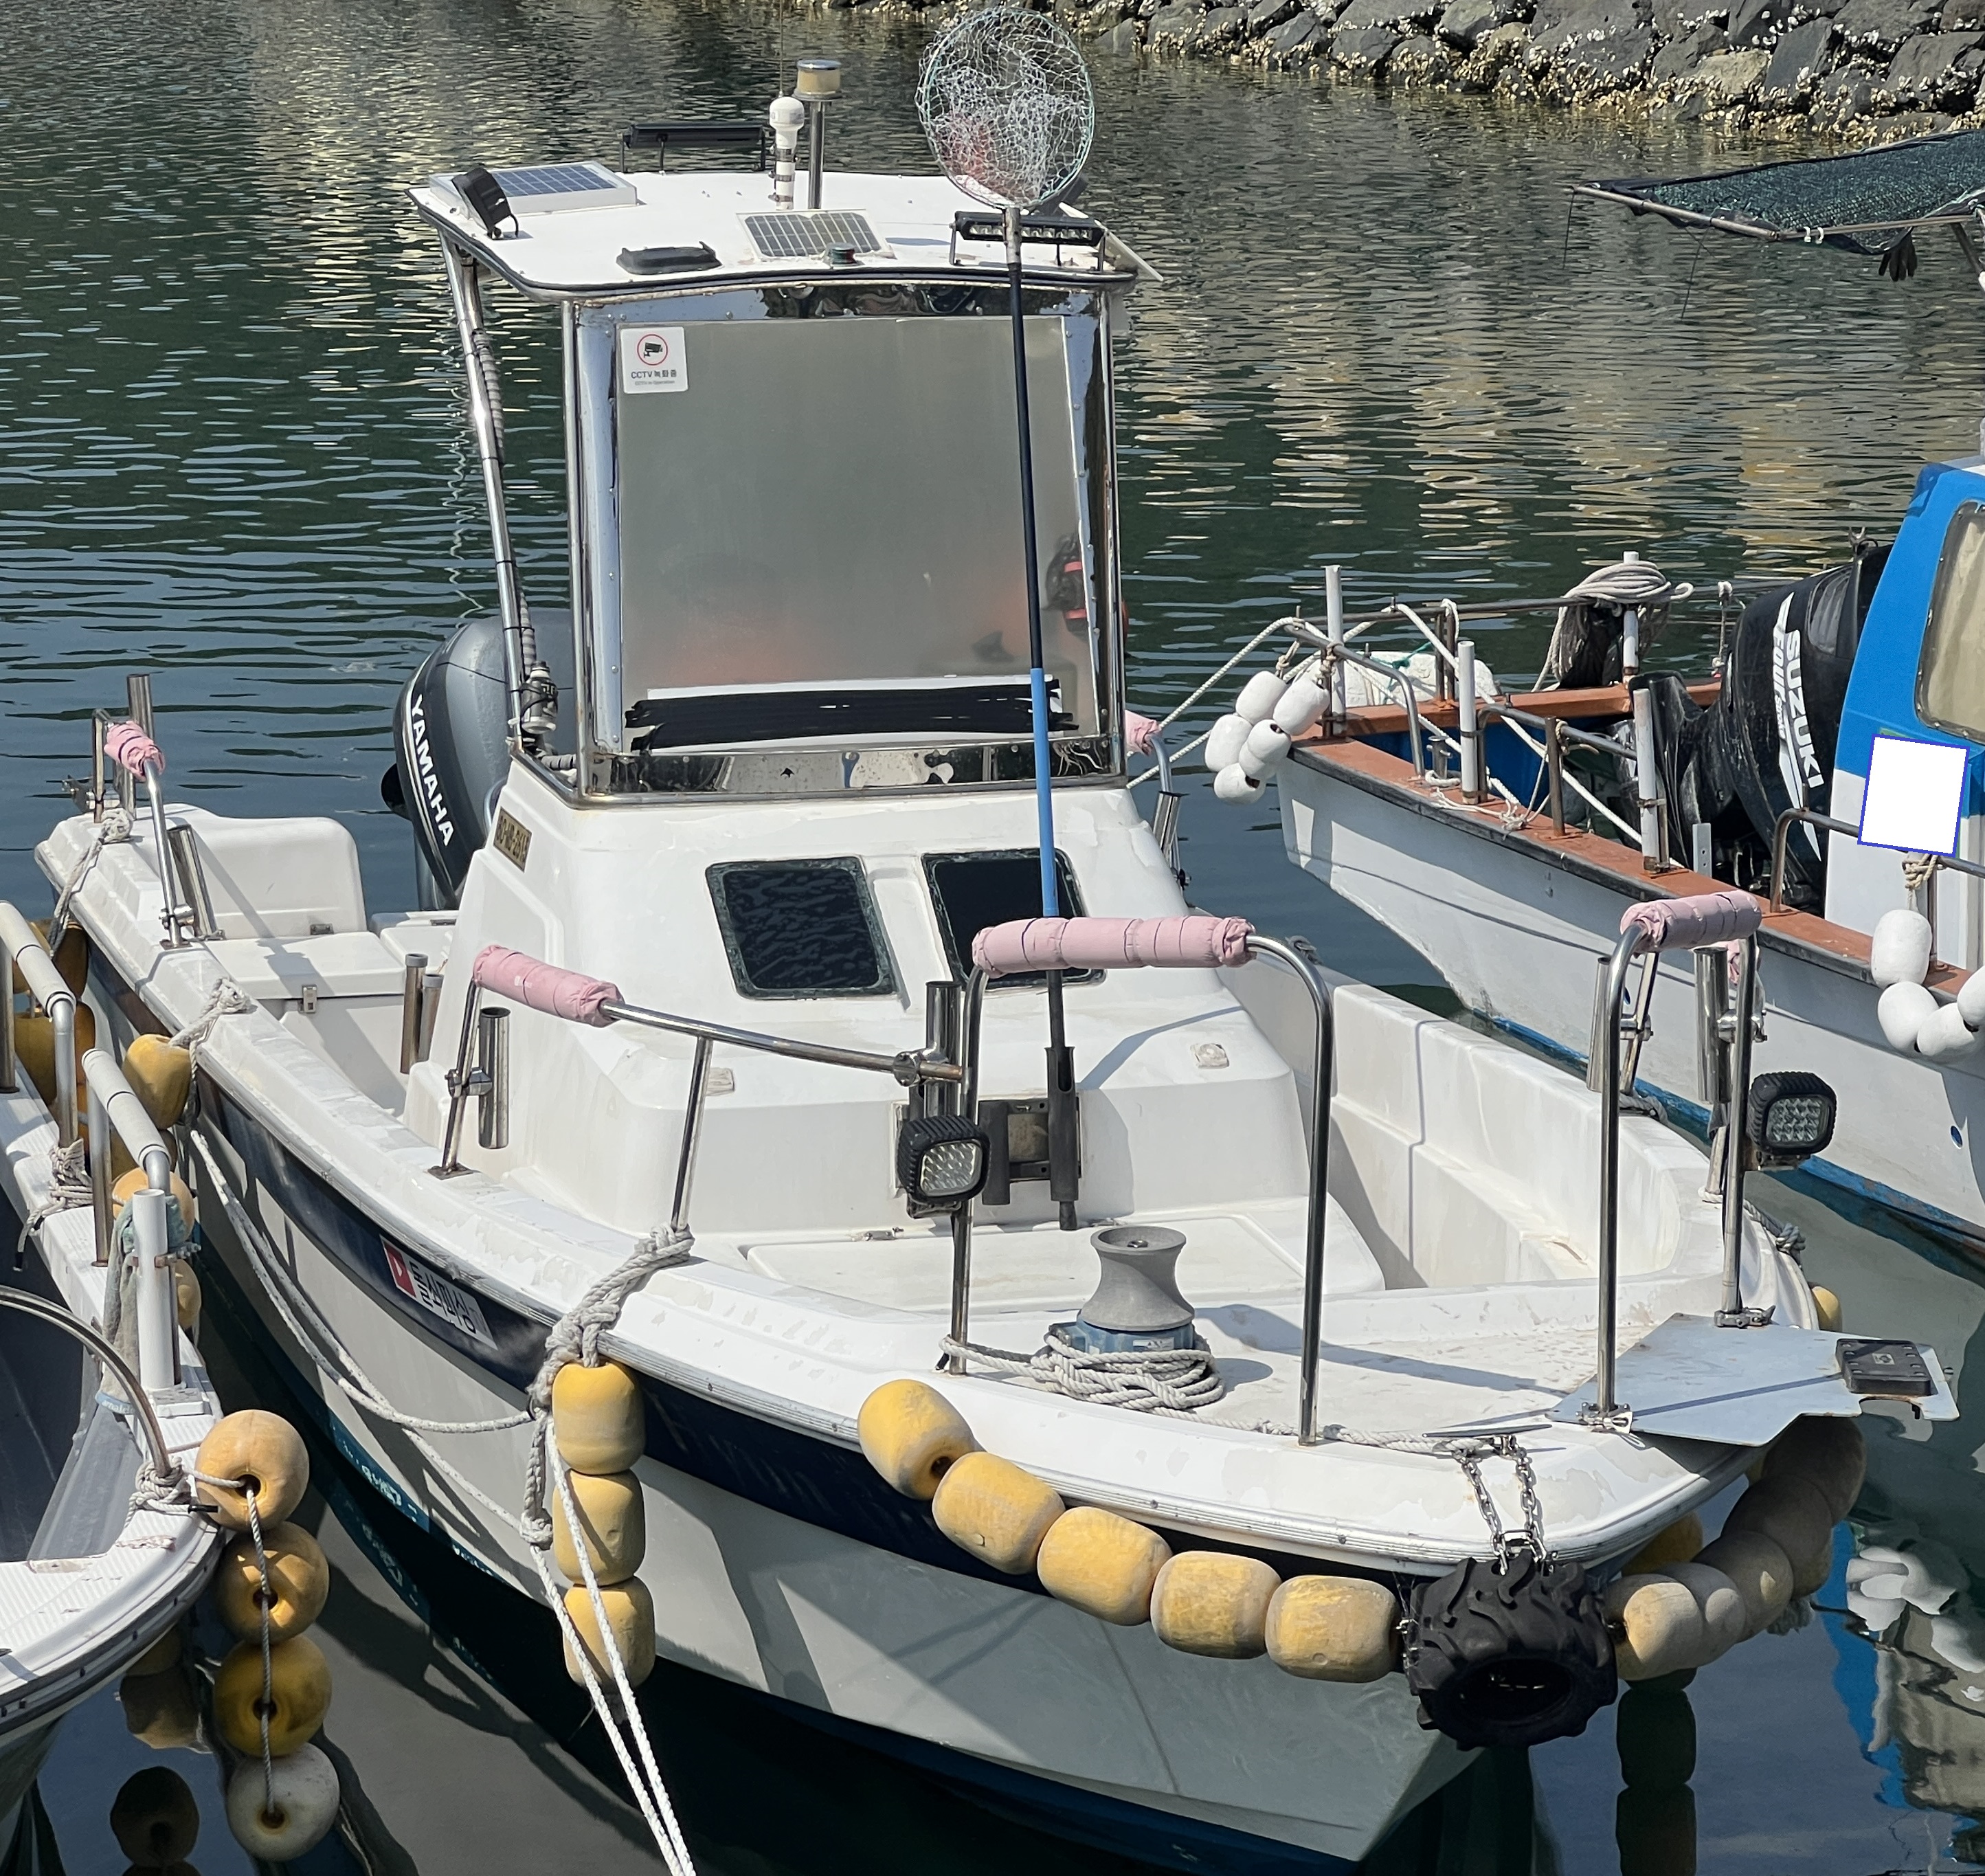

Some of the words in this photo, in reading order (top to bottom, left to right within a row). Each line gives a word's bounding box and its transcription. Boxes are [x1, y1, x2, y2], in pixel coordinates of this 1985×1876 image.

[631, 370, 653, 379] CCTV
[412, 693, 454, 847] YAMAHA
[1787, 629, 1825, 788] SUZUKI
